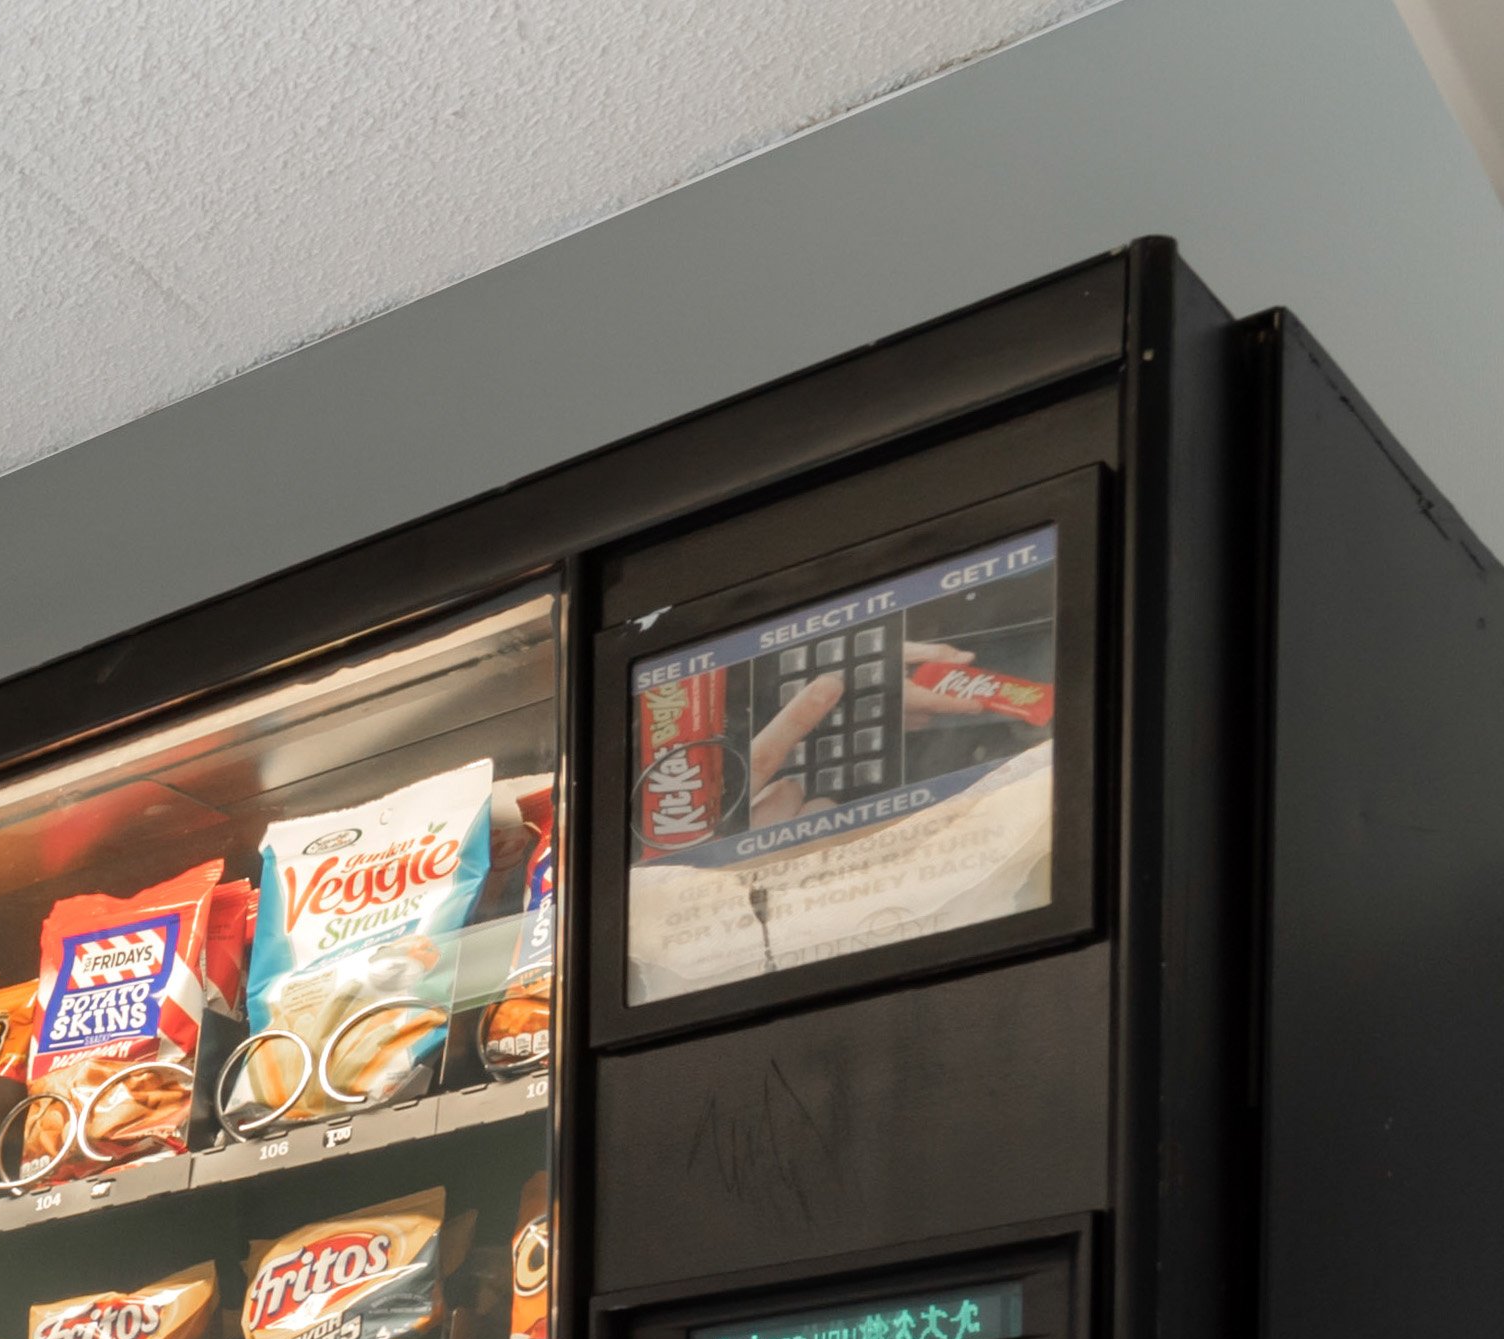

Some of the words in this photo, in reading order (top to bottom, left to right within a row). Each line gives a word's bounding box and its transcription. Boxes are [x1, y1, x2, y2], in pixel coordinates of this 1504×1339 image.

[940, 557, 1000, 590] GET
[1008, 544, 1038, 570] IT.
[759, 602, 860, 650] SELECT
[865, 589, 896, 618] IT.
[637, 663, 681, 689] SEE
[688, 652, 715, 676] IT.
[736, 789, 935, 856] GUARANTEED.
[284, 833, 460, 935] Veggie
[804, 873, 910, 911] MONEY
[318, 895, 422, 950] Straws
[91, 945, 153, 971] FRIDAYS
[56, 982, 151, 1018] POTATO
[49, 1003, 148, 1041] SKINS
[526, 1082, 548, 1099] 10
[259, 1142, 289, 1160] 106
[35, 1194, 61, 1211] 104
[249, 1234, 391, 1331] Fritos
